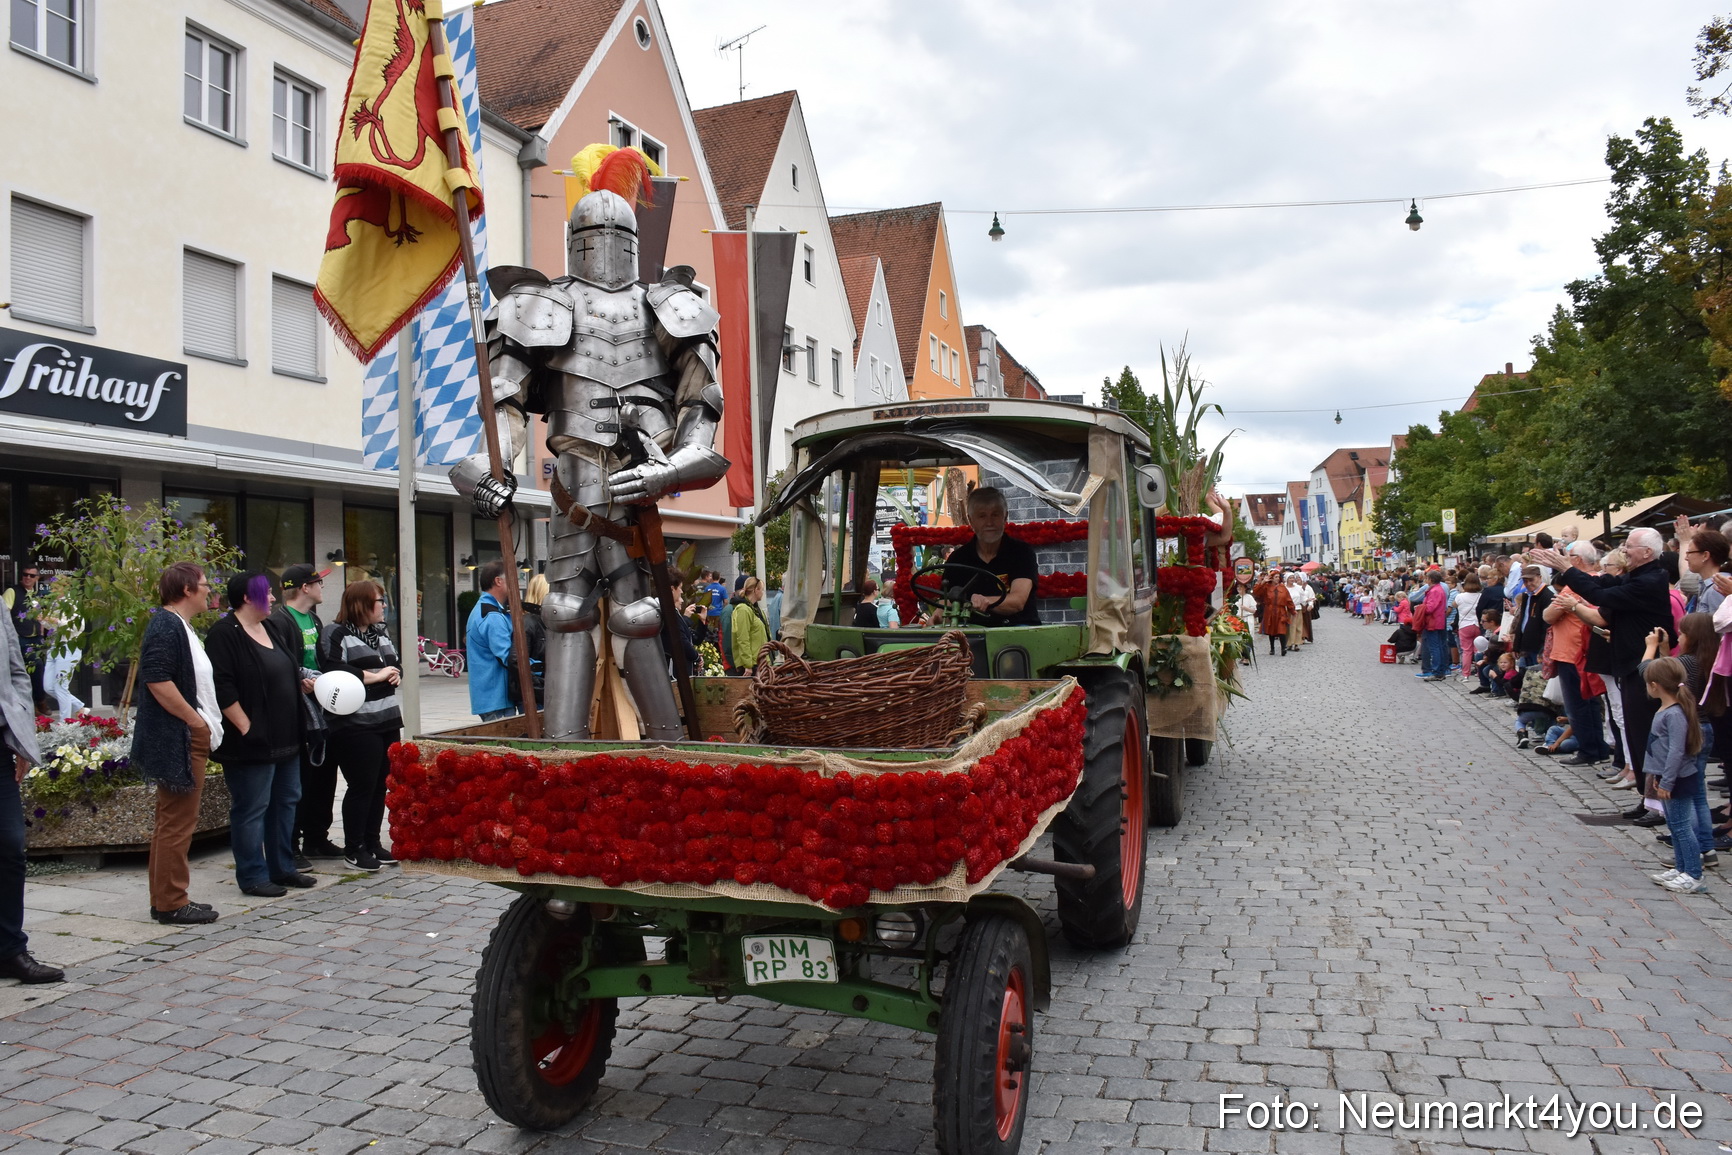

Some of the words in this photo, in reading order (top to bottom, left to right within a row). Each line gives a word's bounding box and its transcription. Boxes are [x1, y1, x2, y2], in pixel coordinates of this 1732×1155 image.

[0, 343, 182, 422] frühauf
[44, 555, 64, 563] Trends
[768, 939, 810, 959] NM
[753, 960, 787, 980] RP
[802, 960, 829, 980] 83
